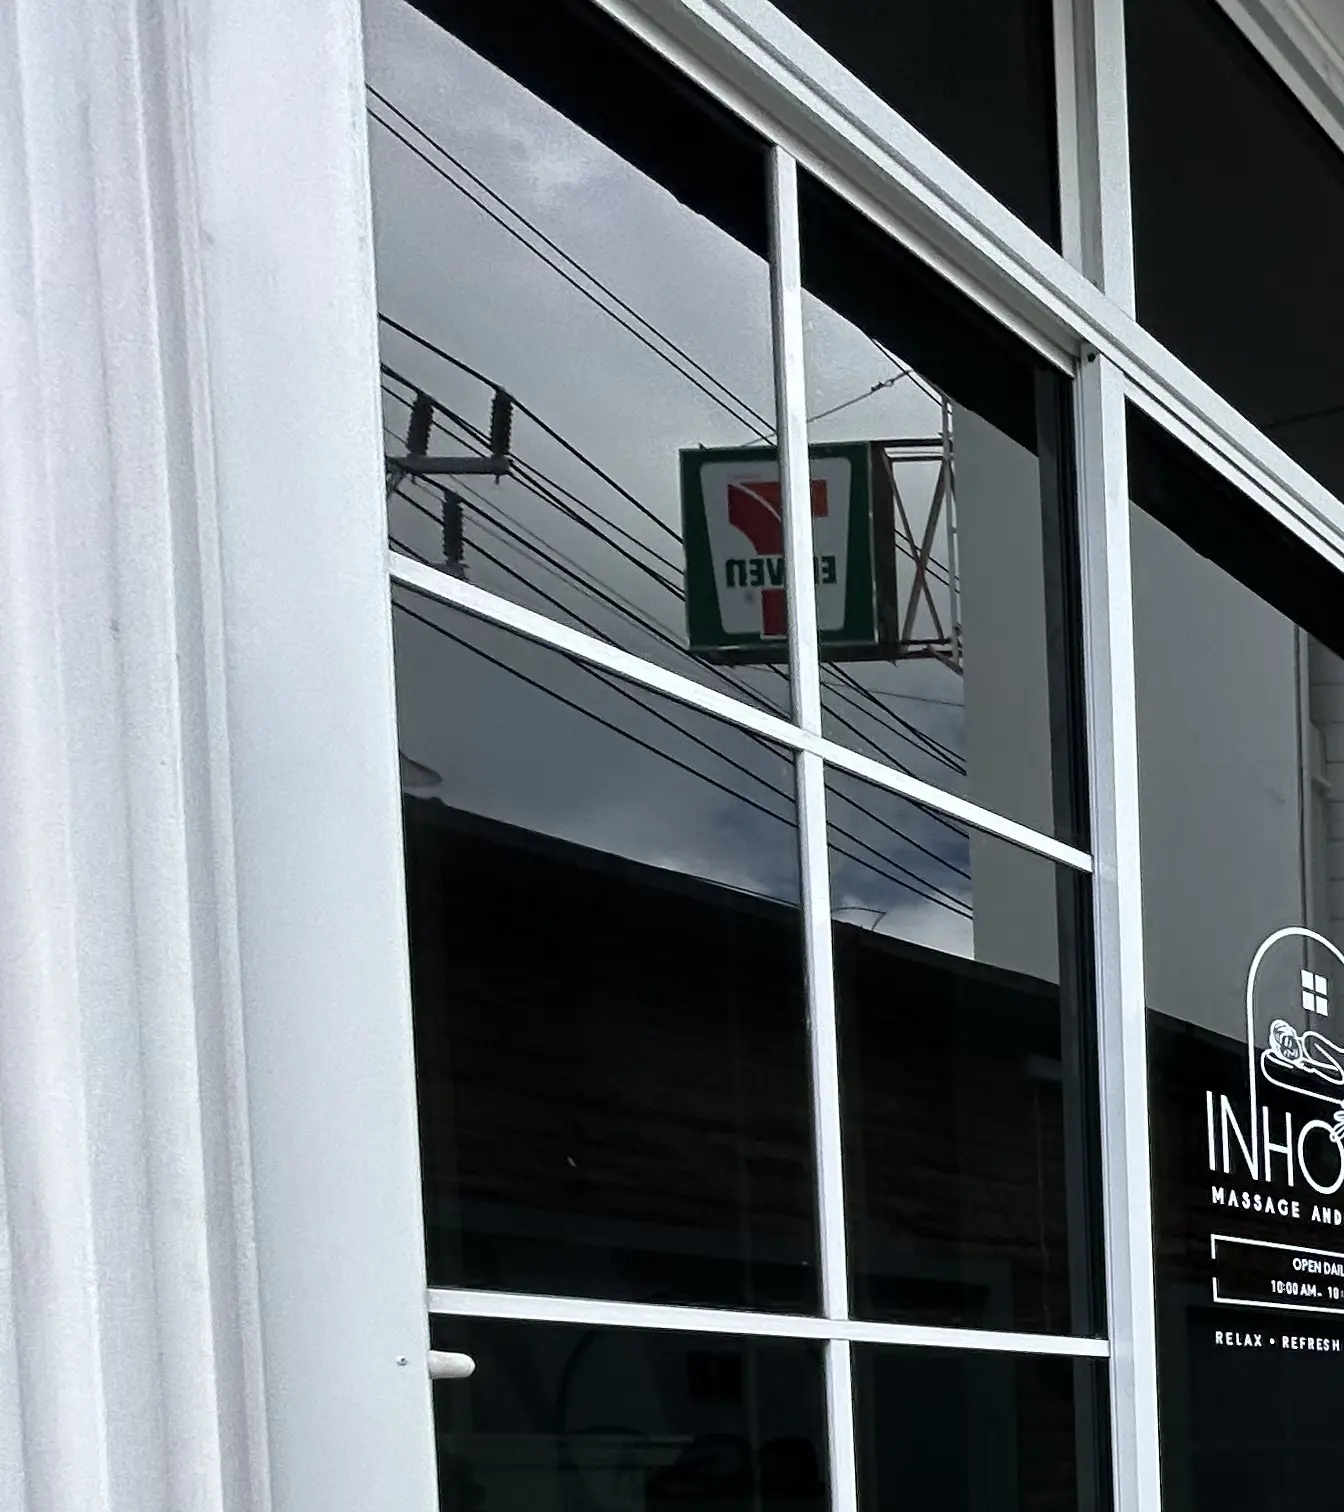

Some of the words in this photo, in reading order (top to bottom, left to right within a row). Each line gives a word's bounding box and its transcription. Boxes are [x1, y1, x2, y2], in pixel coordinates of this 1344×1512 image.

[1211, 1185, 1300, 1218] MASSAGE
[1311, 1205, 1342, 1226] AND
[1292, 1257, 1322, 1274] OPEN
[1270, 1279, 1299, 1295] 10:00
[1215, 1331, 1262, 1347] RELAX
[1281, 1335, 1341, 1352] REFRESH
